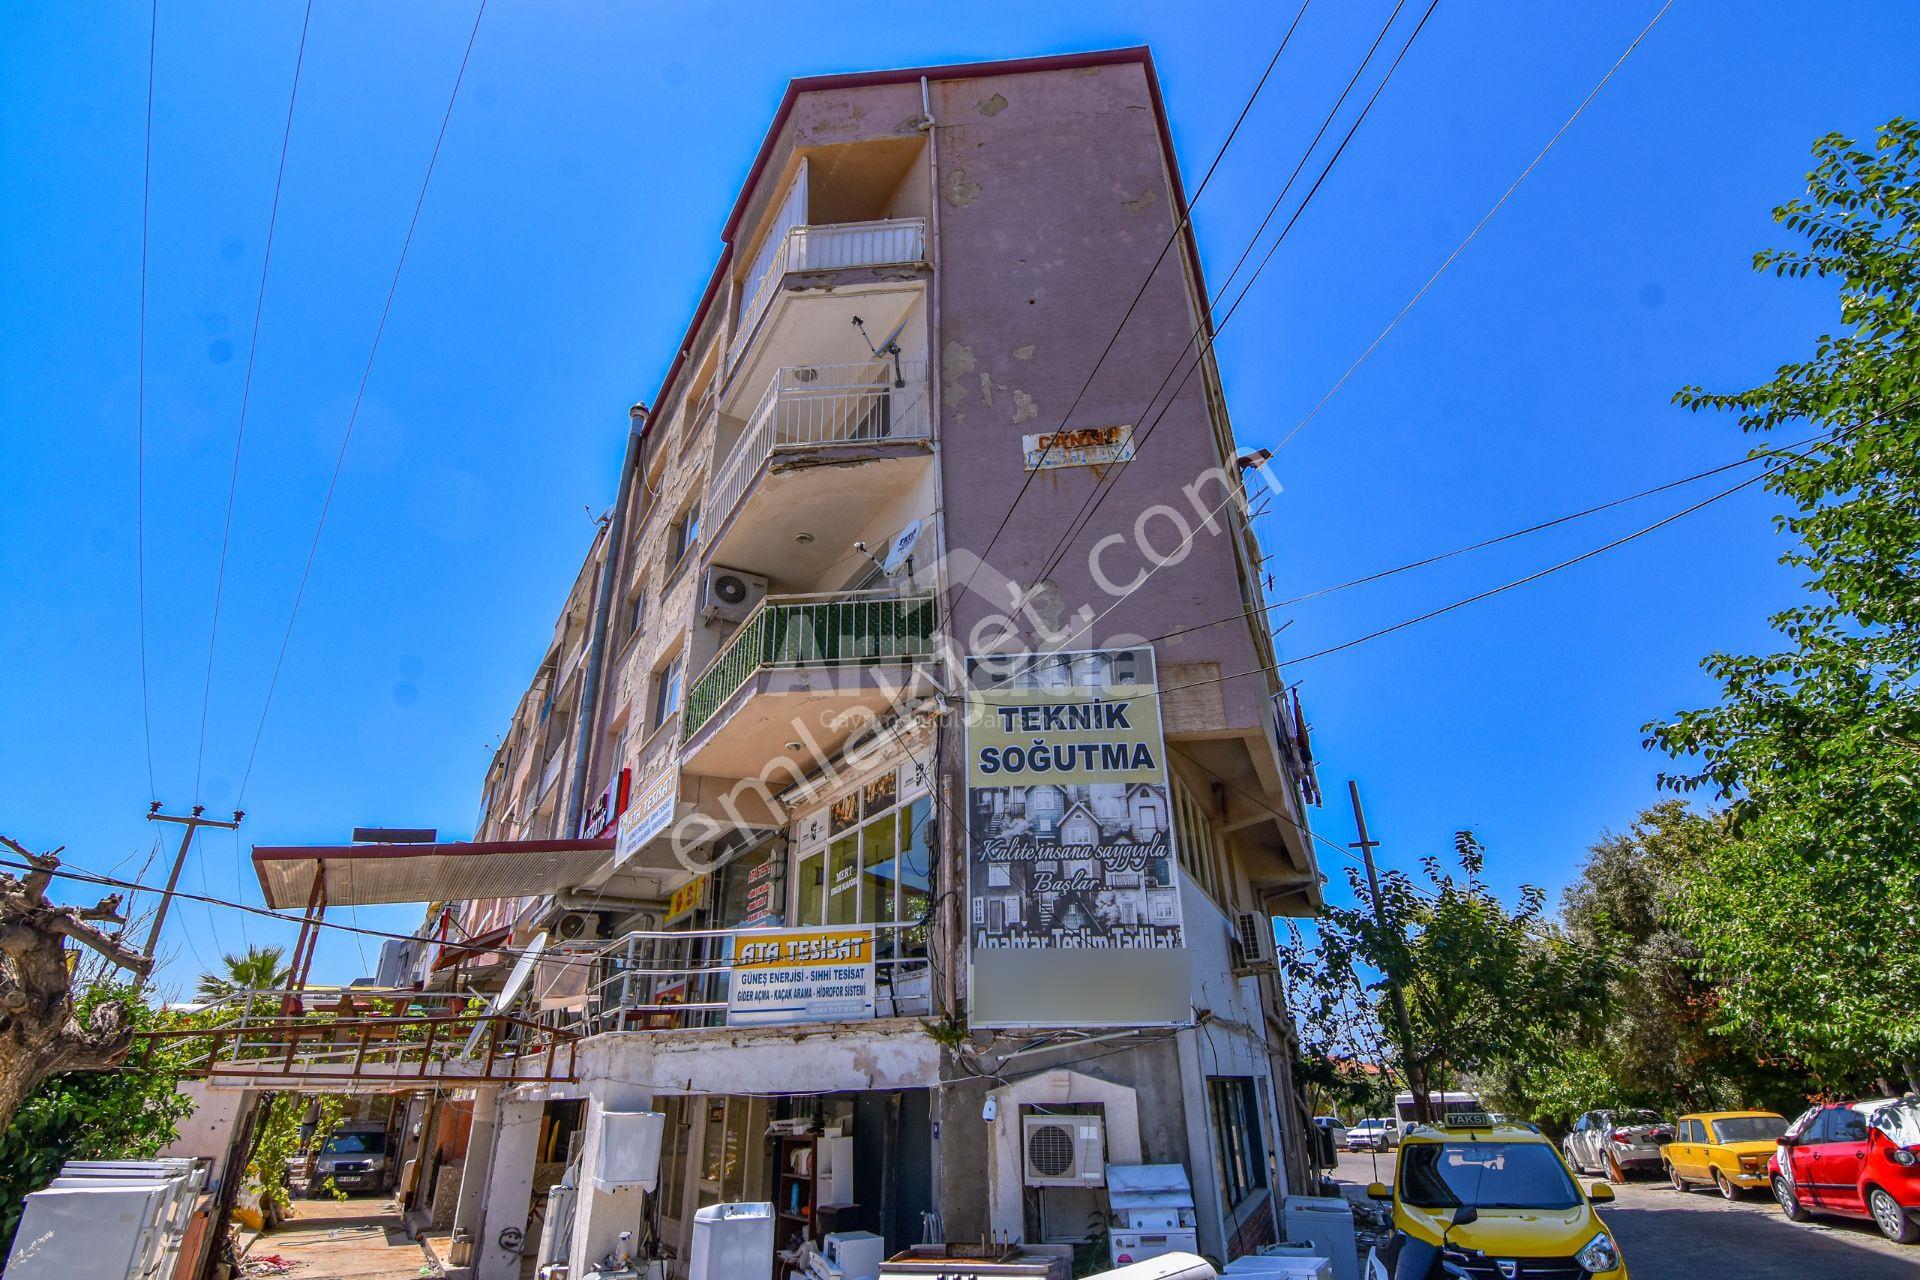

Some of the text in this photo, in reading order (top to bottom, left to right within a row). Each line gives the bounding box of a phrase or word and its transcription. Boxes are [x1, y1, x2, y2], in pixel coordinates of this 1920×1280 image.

[998, 698, 1131, 733] TEKNİK
[979, 738, 1156, 774] SOĞUTMA
[1094, 832, 1167, 871] saygıyla
[741, 935, 864, 964] ATA TESİSAT
[741, 972, 768, 987] GÜNEŞ
[769, 970, 804, 984] ENERJİSİ
[810, 967, 832, 982] SIHHİ
[833, 966, 865, 981] TESİSAT
